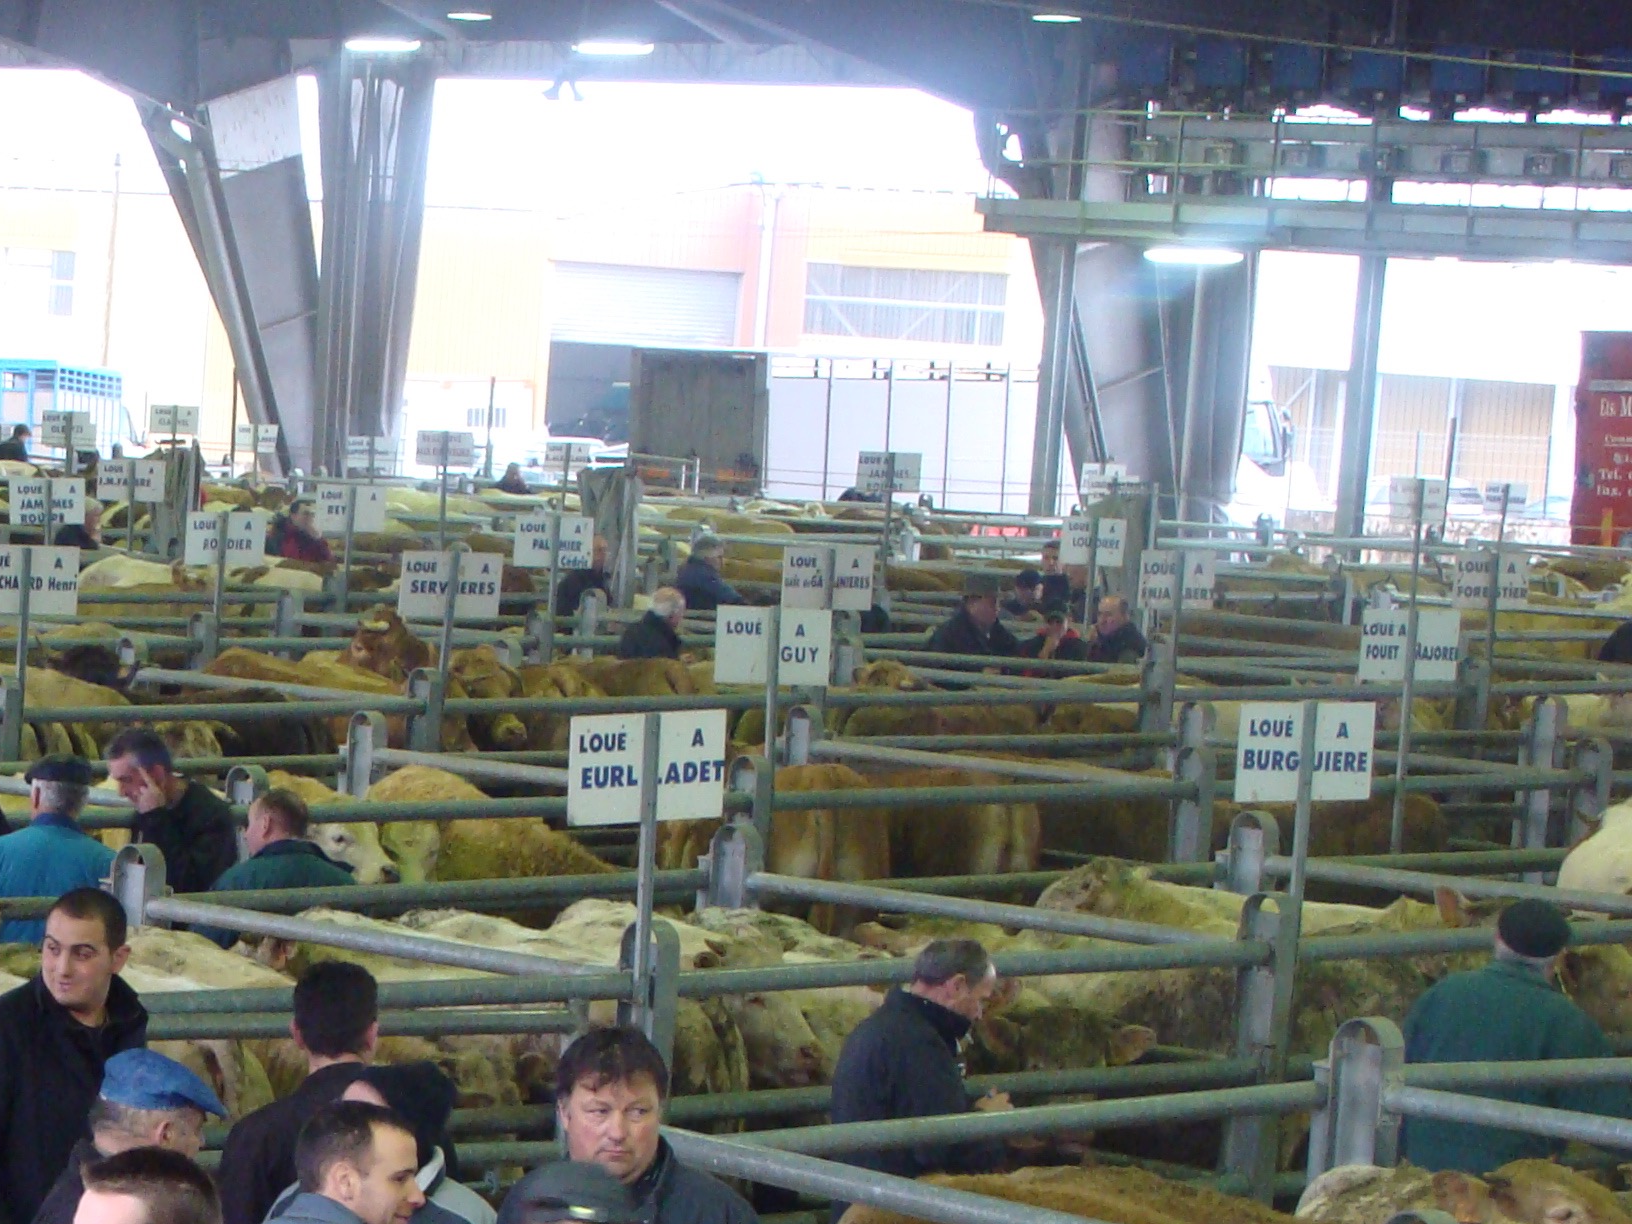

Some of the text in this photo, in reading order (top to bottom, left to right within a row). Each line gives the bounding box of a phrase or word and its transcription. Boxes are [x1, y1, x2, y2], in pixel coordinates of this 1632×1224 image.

[54, 556, 64, 570] A
[795, 624, 806, 637] A
[1398, 624, 1407, 637] A
[781, 646, 819, 663] GUY
[691, 728, 705, 747] A
[1336, 721, 1349, 739] A
[580, 760, 726, 790] EURL ADET
